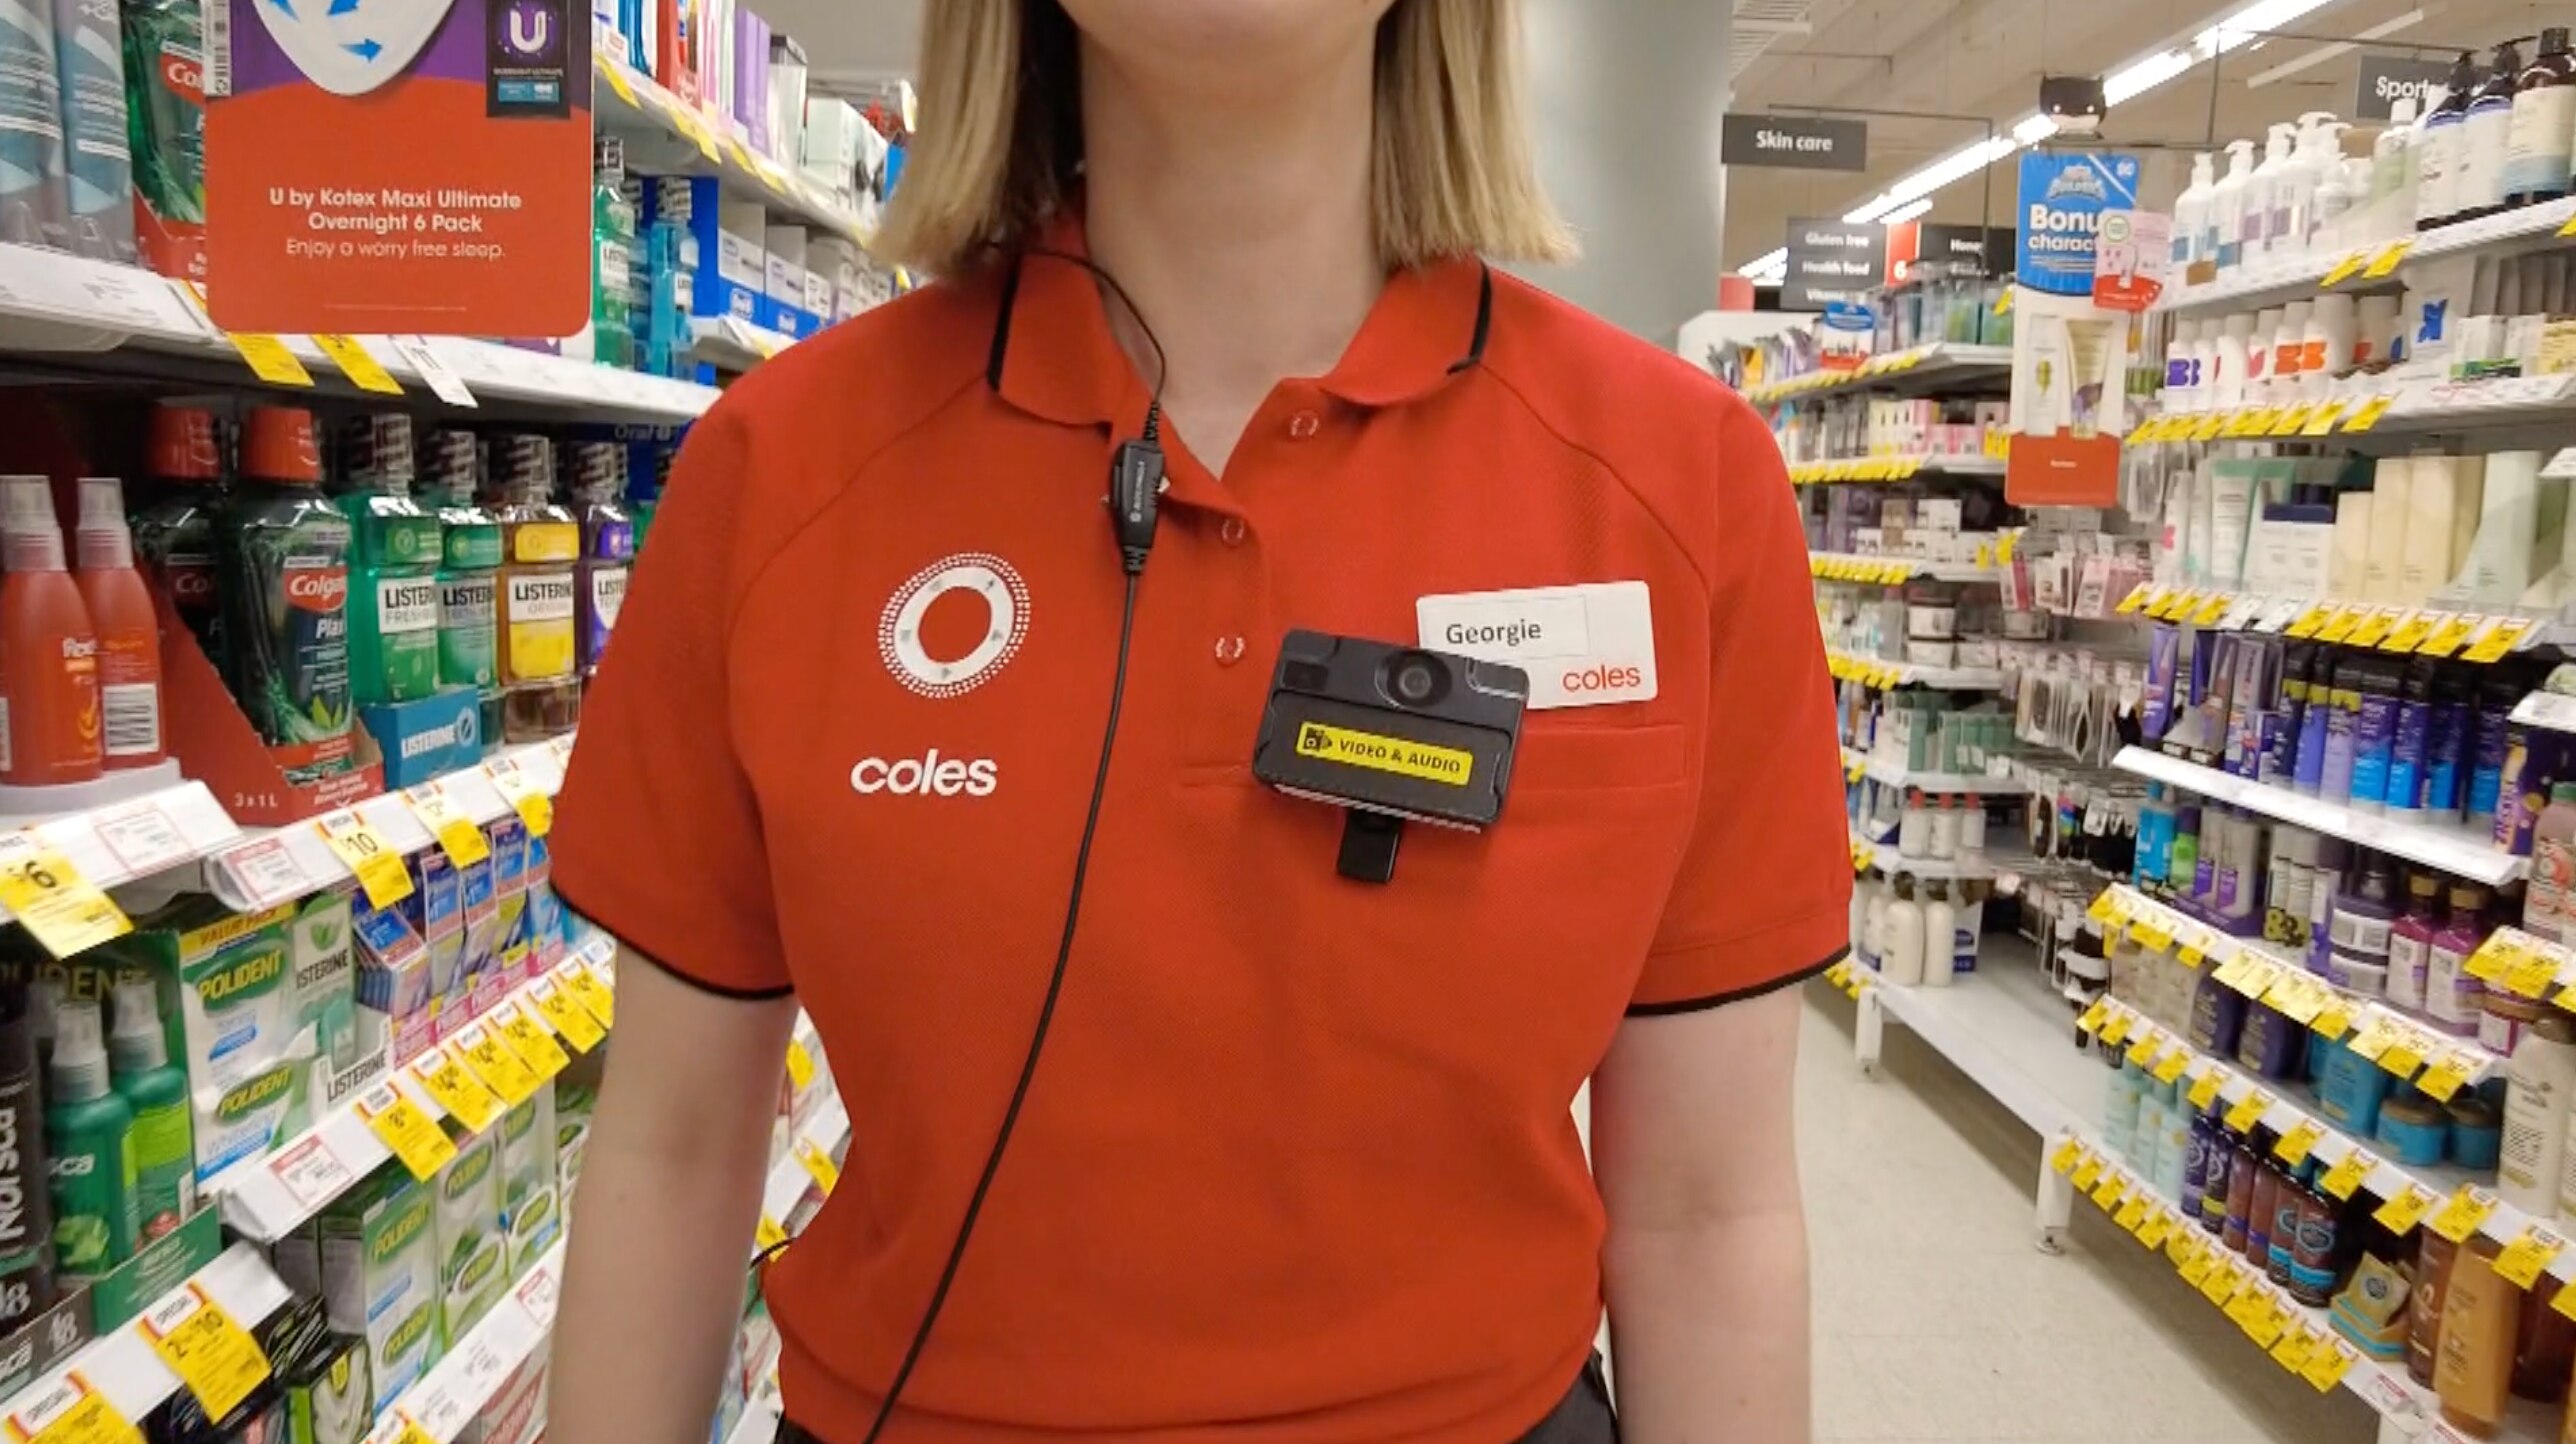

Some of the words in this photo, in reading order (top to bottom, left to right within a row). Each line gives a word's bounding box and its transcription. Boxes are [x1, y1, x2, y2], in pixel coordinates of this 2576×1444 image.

[2375, 75, 2429, 100] Sport
[1755, 129, 1793, 149] Skin
[1796, 136, 1833, 151] care
[269, 188, 284, 206] U
[289, 188, 314, 208] by
[320, 188, 376, 207] Kotex
[382, 189, 431, 208] Maxi
[437, 190, 522, 209] Ultimate
[308, 212, 408, 235] Overnight
[414, 213, 426, 232] 6
[432, 213, 483, 233] Pack
[286, 238, 335, 259] Enjoy
[339, 243, 354, 257] a
[359, 242, 408, 259] worry
[412, 239, 447, 257] free
[452, 240, 505, 261] sleep.
[1804, 231, 1844, 247] Gluten
[1846, 233, 1870, 248] free
[2028, 233, 2097, 252] charact
[1801, 260, 1842, 274] Health
[1842, 260, 1871, 276] food
[1446, 618, 1542, 647] Georgie
[1562, 664, 1642, 693] coles
[401, 723, 457, 759] LISTERINE
[1339, 738, 1387, 759] VIDEO
[1390, 749, 1403, 762] &
[1407, 752, 1461, 773] AUDIO
[850, 747, 998, 797] coles
[199, 947, 282, 1000] POLIDENT
[296, 949, 349, 991] ISTERINE
[327, 1050, 387, 1103] LISTERINE
[218, 1065, 292, 1118] POLIDENT
